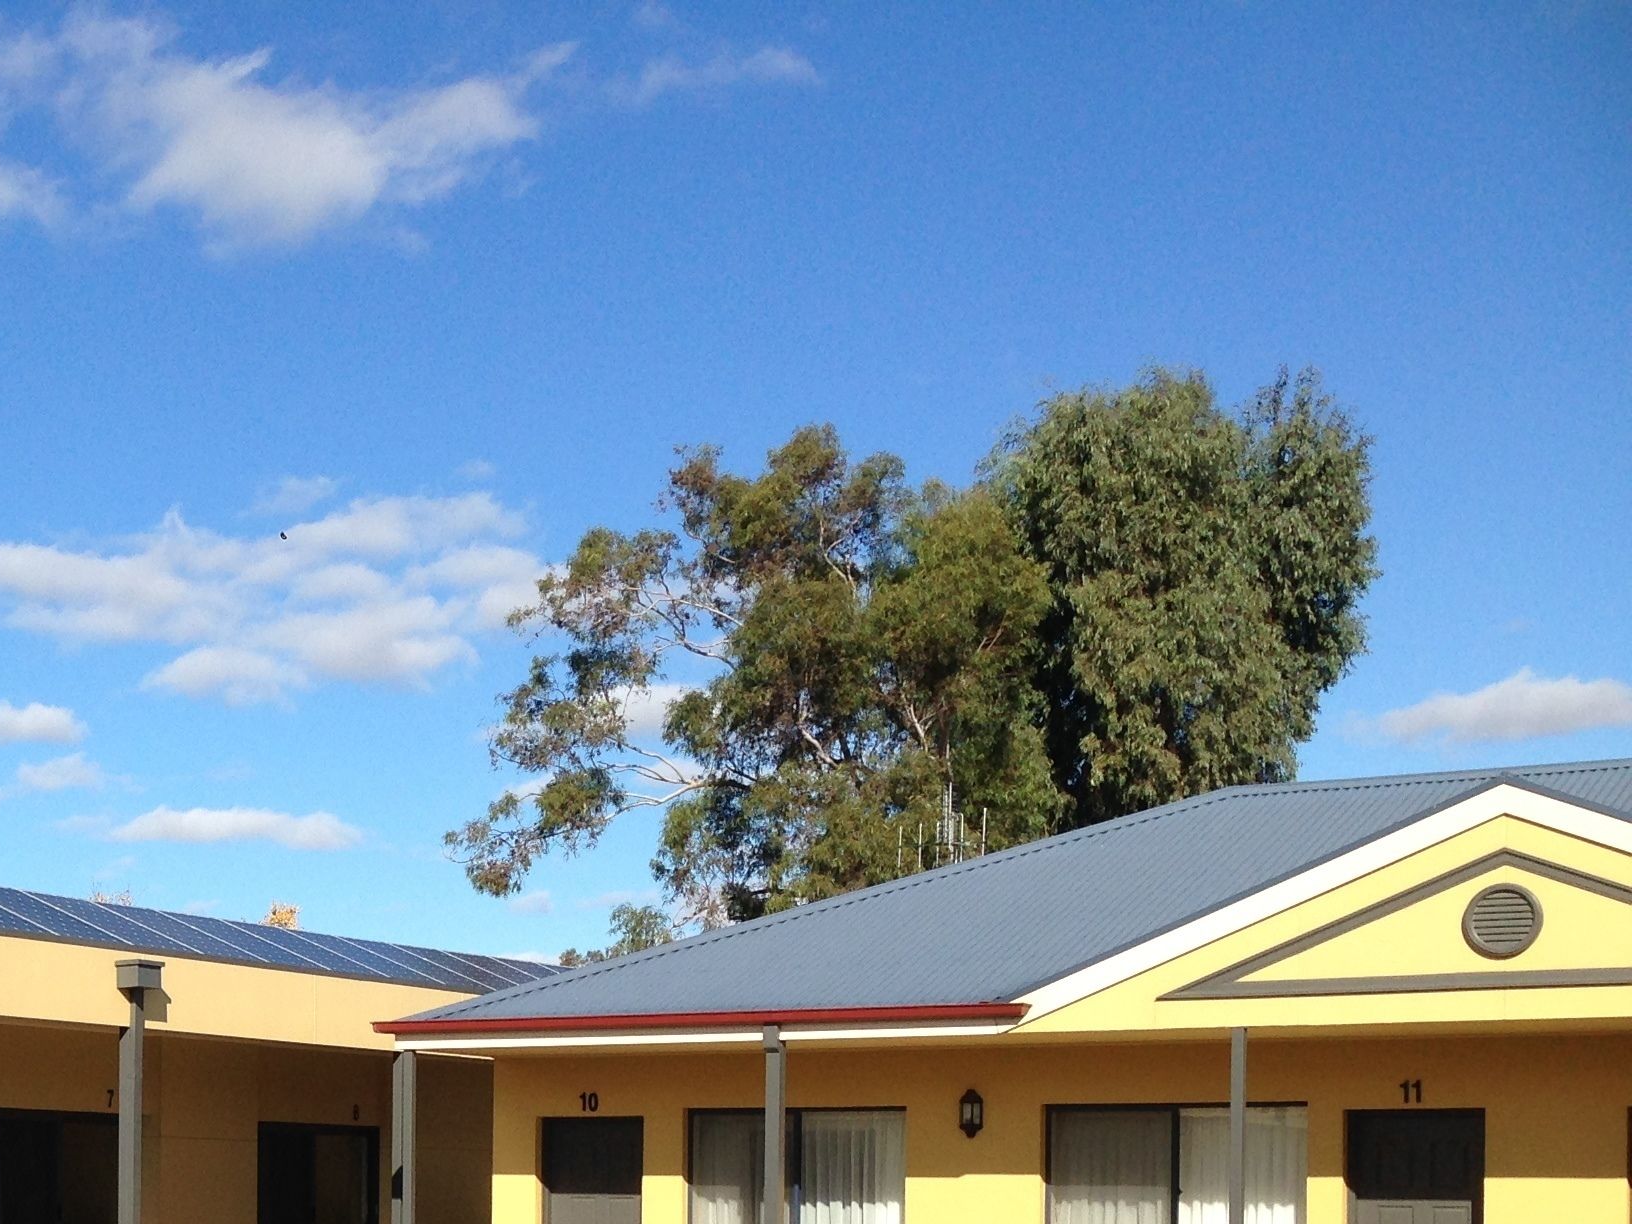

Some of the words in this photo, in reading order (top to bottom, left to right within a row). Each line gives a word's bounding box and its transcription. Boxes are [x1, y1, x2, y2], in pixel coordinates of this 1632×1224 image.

[106, 1089, 115, 1108] 7
[579, 1091, 598, 1112] 10
[1399, 1079, 1422, 1104] 11
